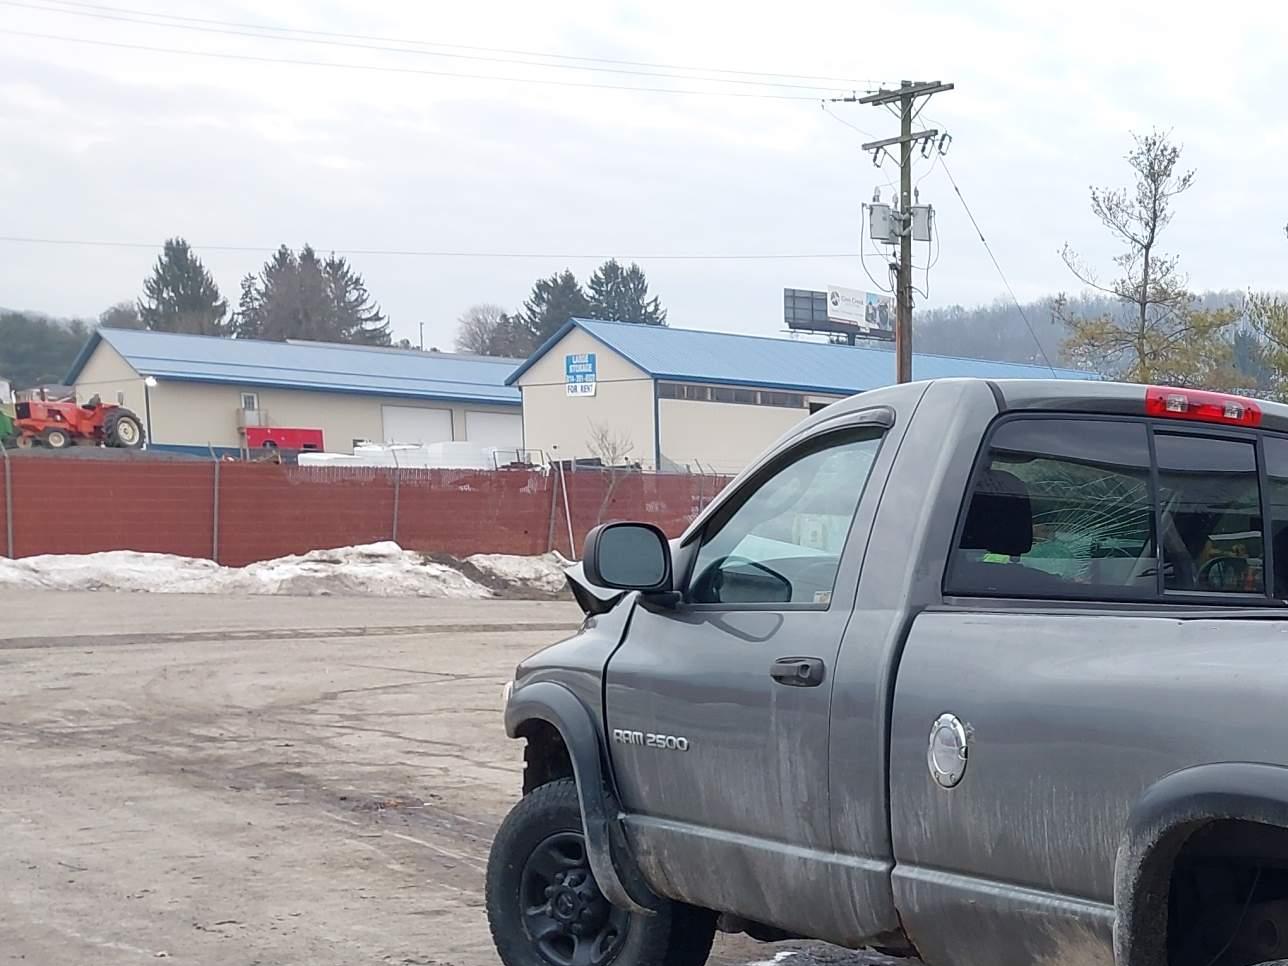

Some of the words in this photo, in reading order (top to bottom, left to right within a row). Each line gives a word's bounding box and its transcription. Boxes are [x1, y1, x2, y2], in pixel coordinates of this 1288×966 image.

[568, 385, 577, 393] FOR
[580, 384, 592, 393] RENT
[613, 729, 644, 746] RAM
[646, 733, 689, 751] 2500
